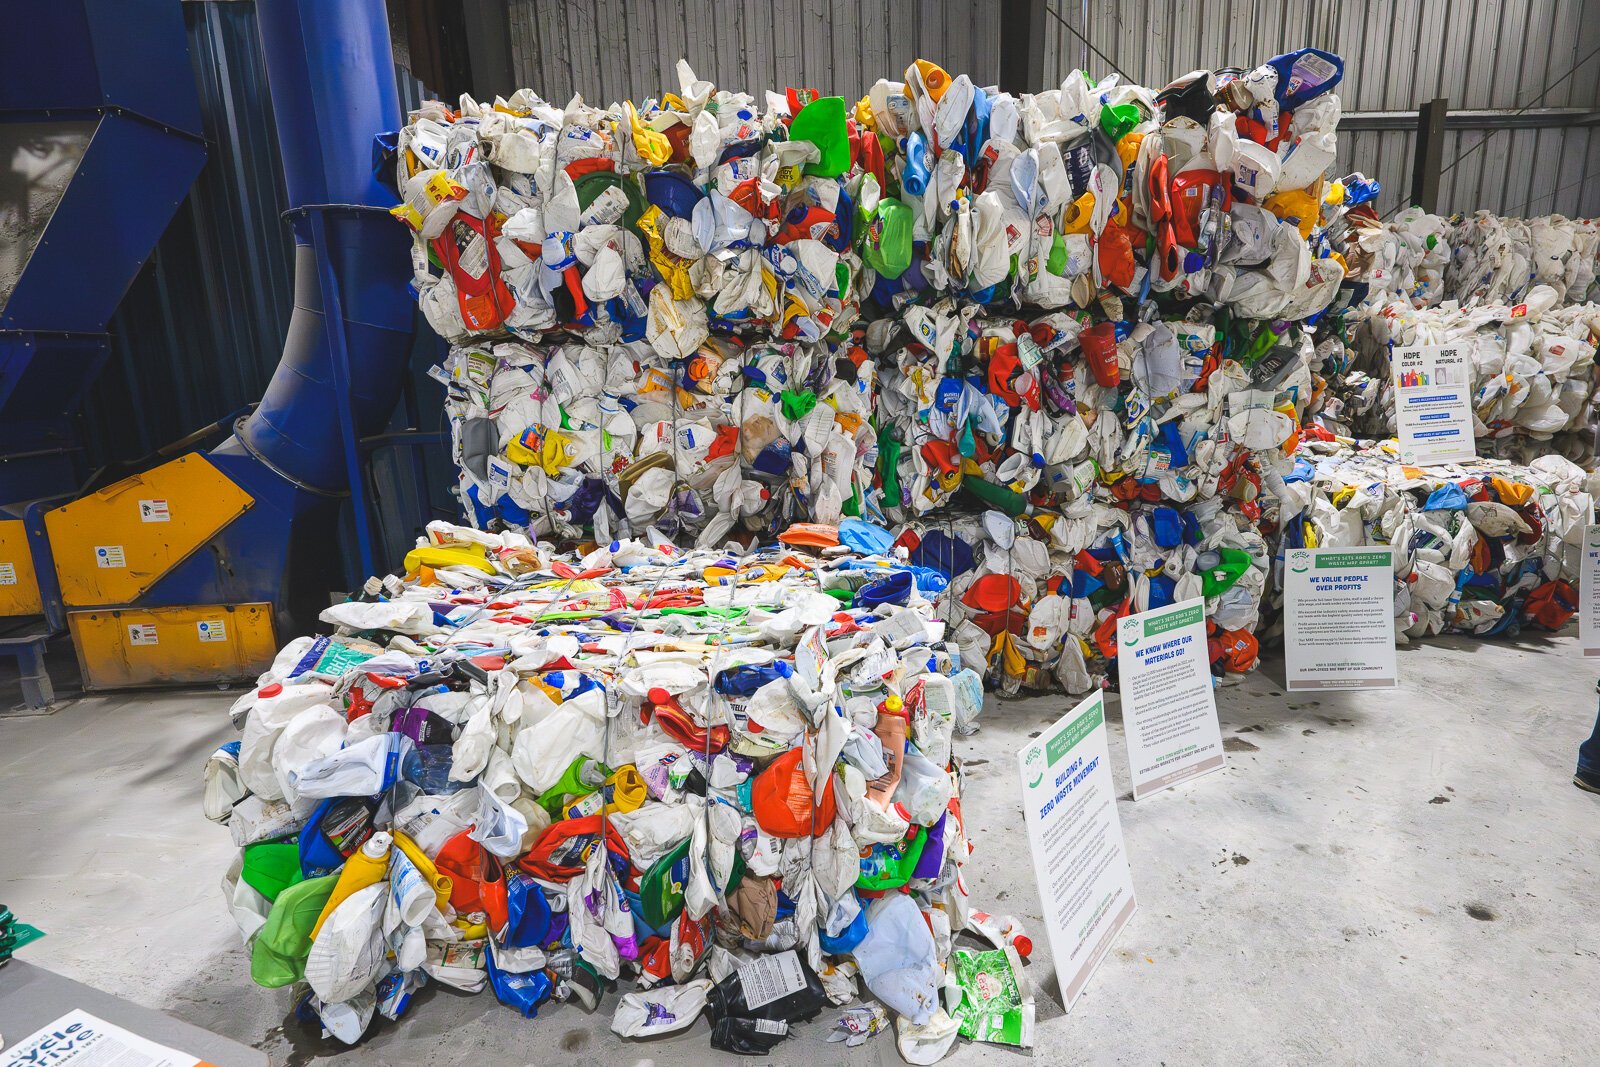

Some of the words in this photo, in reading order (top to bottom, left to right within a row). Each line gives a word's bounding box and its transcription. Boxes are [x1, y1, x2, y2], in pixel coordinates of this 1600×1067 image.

[1136, 649, 1144, 658] WE
[1146, 645, 1161, 655] KNOW
[1163, 639, 1180, 650] WHERE
[1182, 636, 1192, 644] OUR
[1145, 650, 1174, 666] MATERIALS
[1176, 648, 1184, 656] GO!
[1055, 761, 1078, 788] BUILDING
[1079, 756, 1082, 766] A
[1040, 800, 1054, 820] ZERO
[1055, 782, 1072, 804] WASTE
[1073, 756, 1100, 787] MOVEMENT
[10, 1034, 49, 1058] Used
[26, 1030, 94, 1067] rive
